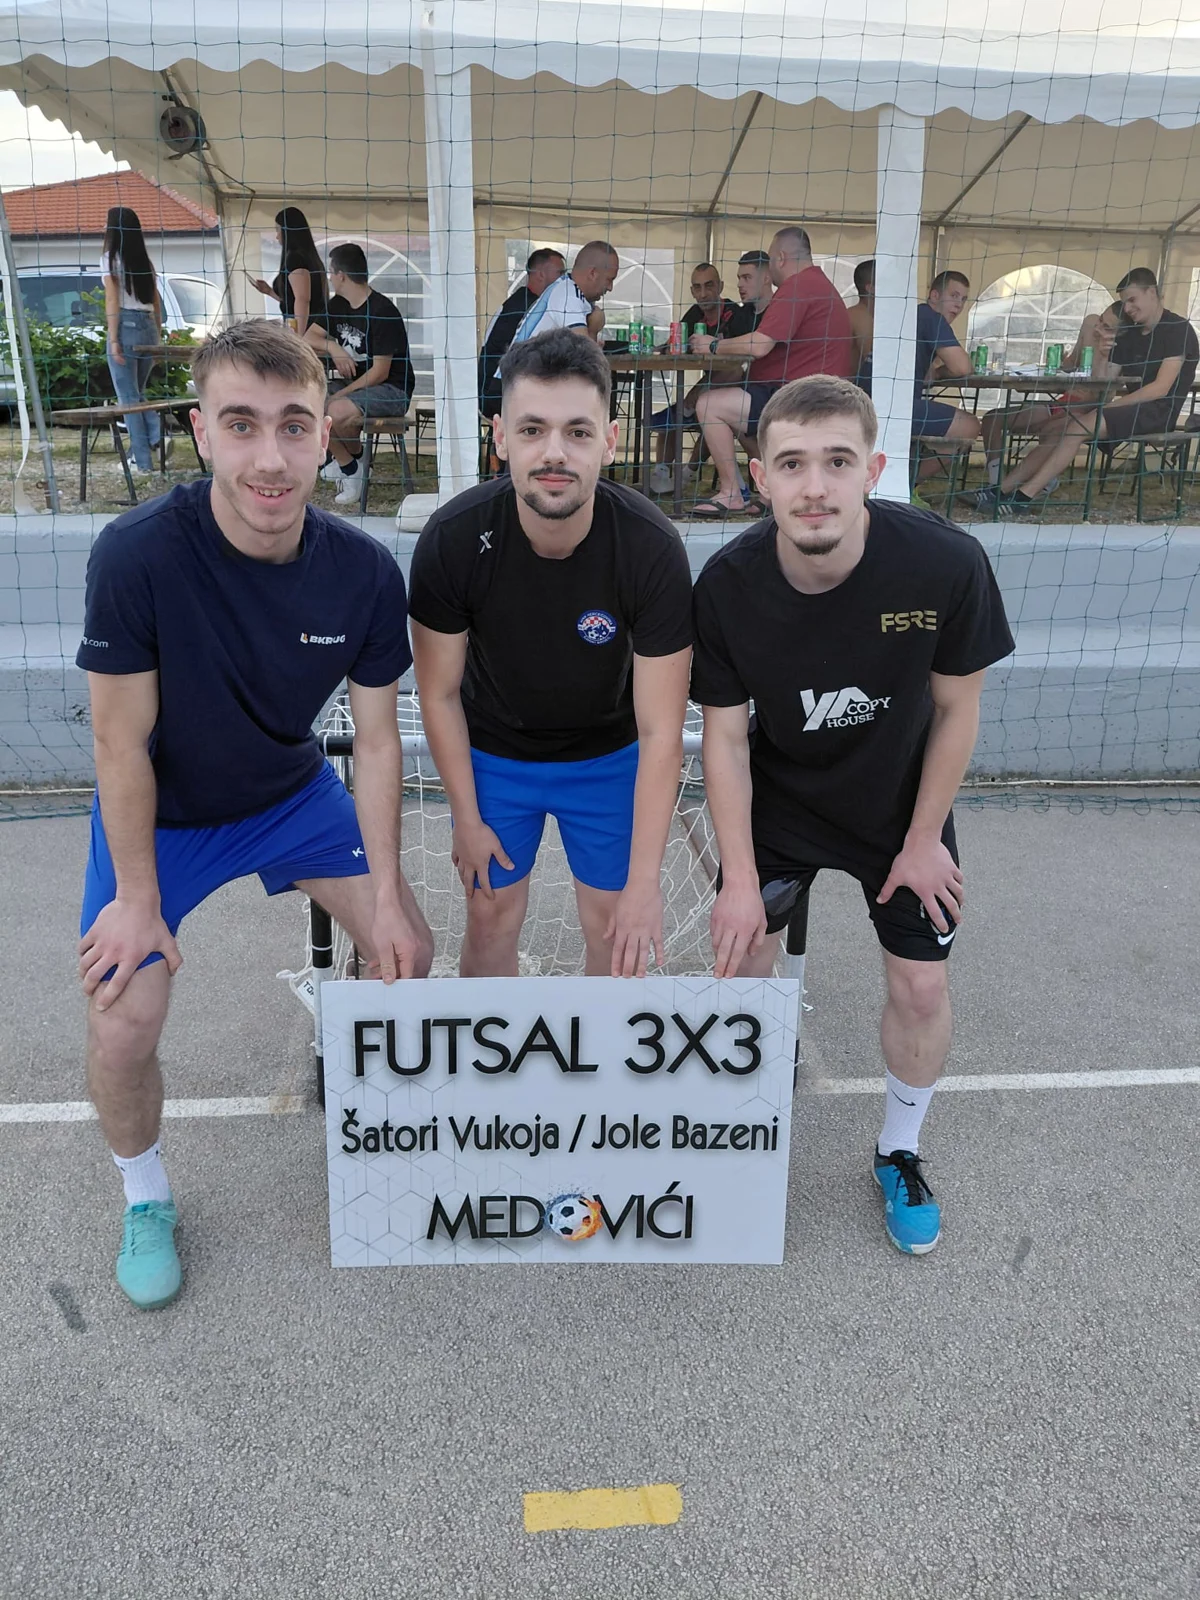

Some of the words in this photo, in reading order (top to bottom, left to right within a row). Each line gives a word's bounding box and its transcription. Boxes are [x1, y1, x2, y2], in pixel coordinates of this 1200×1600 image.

[880, 609, 938, 633] FSRE
[309, 634, 346, 645] BKRUG
[846, 696, 892, 716] COPY
[826, 712, 875, 729] HOUSE
[354, 1014, 599, 1078] FUTSAL
[624, 1012, 762, 1076] 3X3
[341, 1108, 438, 1154] Šatori
[448, 1113, 560, 1157] Vukoja
[591, 1113, 661, 1150] Jole
[671, 1114, 779, 1151] Bazeni
